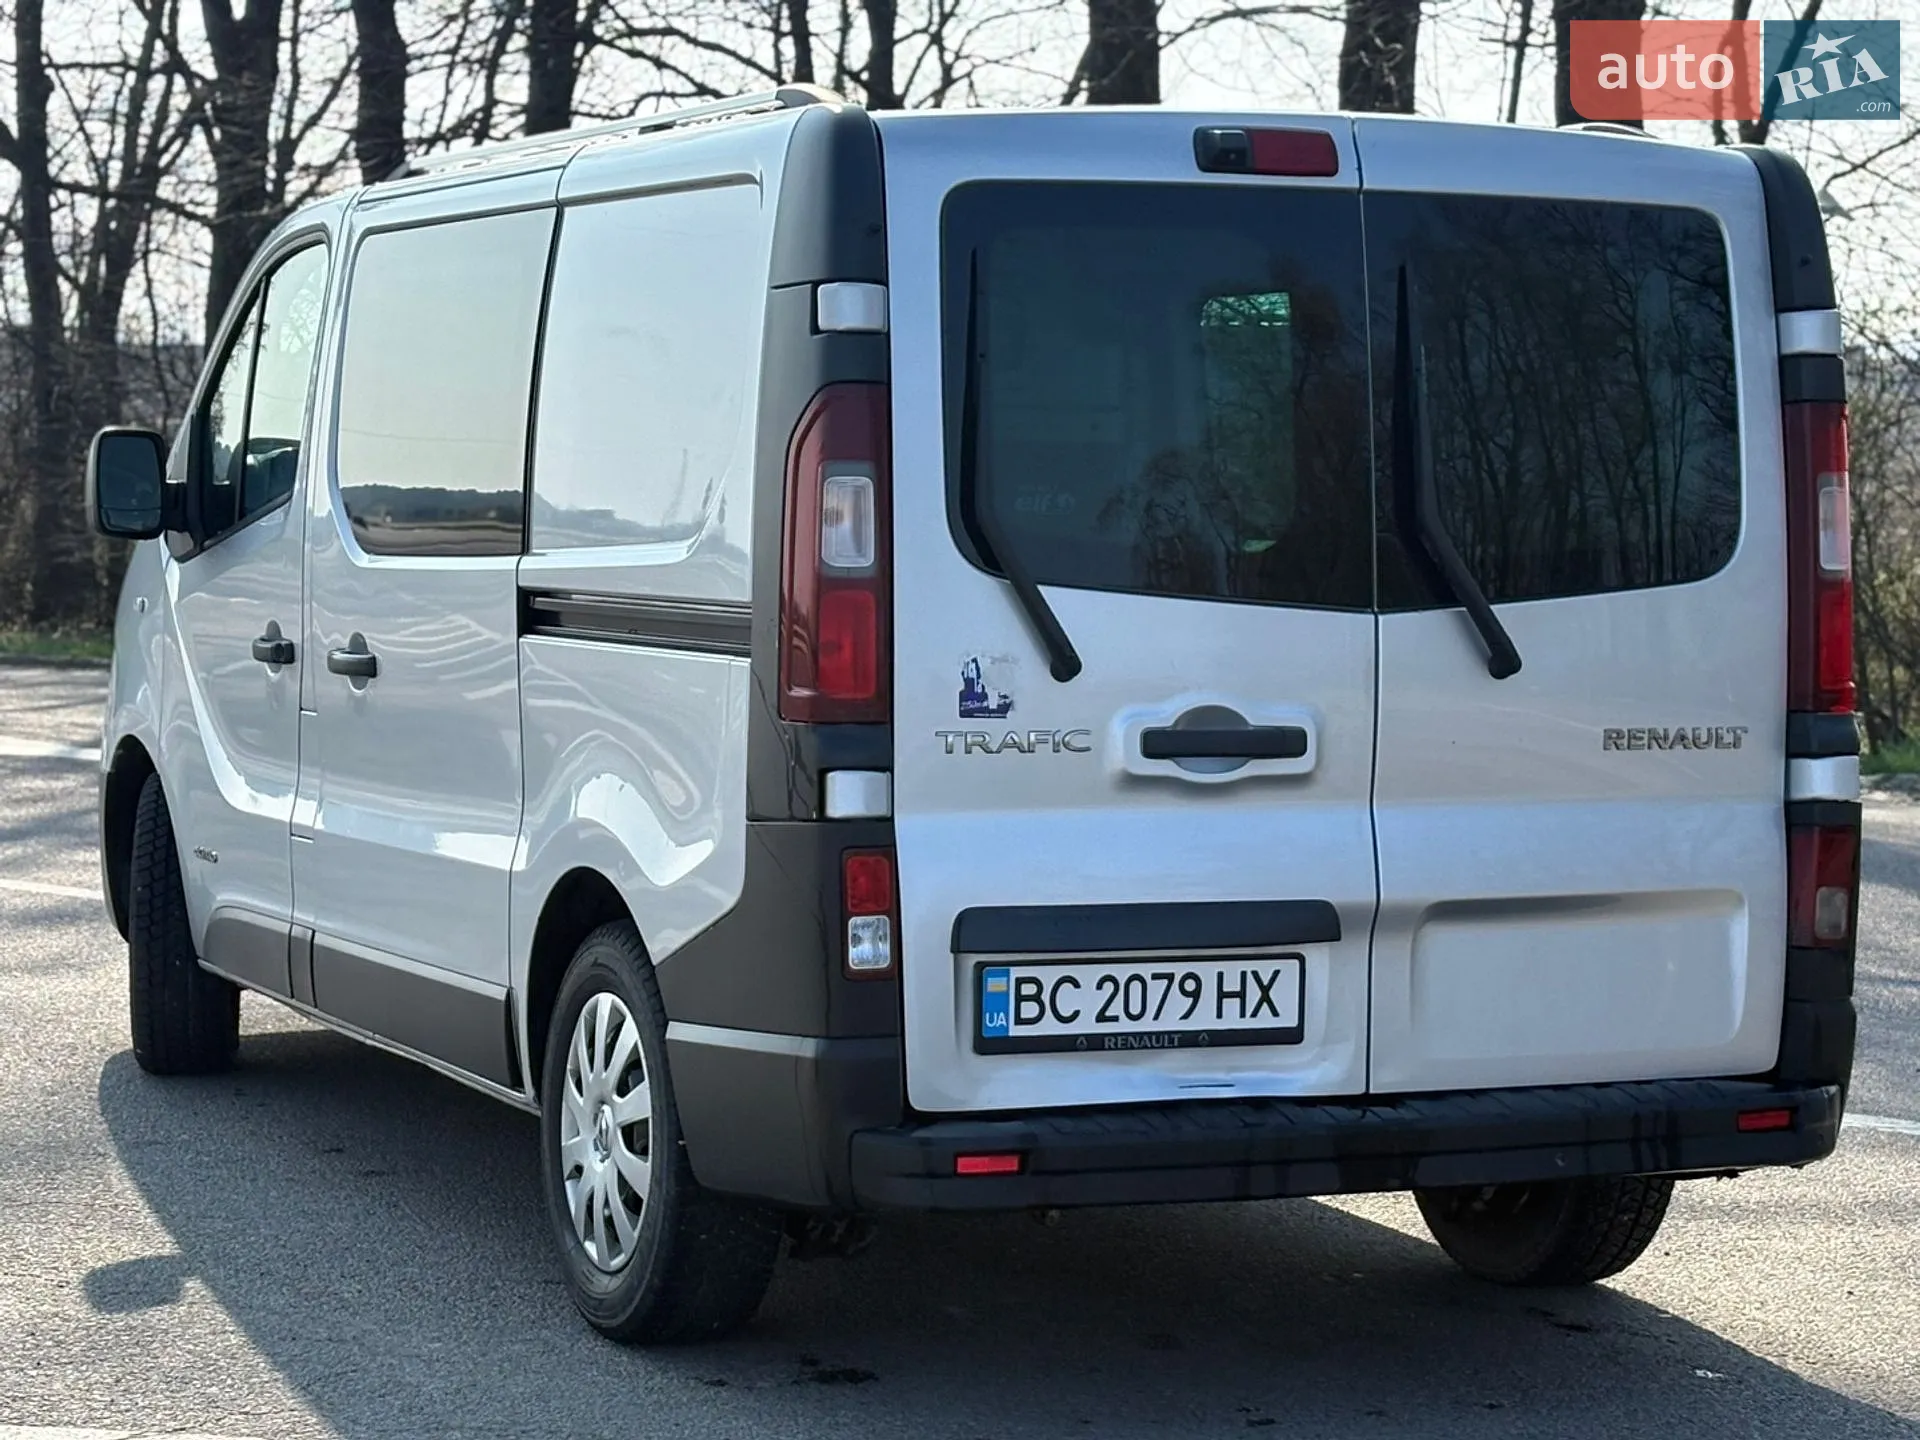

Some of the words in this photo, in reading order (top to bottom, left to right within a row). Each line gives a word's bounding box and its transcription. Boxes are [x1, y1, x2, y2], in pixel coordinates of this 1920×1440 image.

[935, 729, 1093, 754] TRAFIC
[1603, 726, 1748, 751] RENAULT
[1013, 975, 1082, 1026] BC
[1095, 971, 1202, 1024] 2079
[1216, 969, 1281, 1019] HX
[986, 1012, 1008, 1028] UA
[1103, 1034, 1182, 1050] RENAULT
